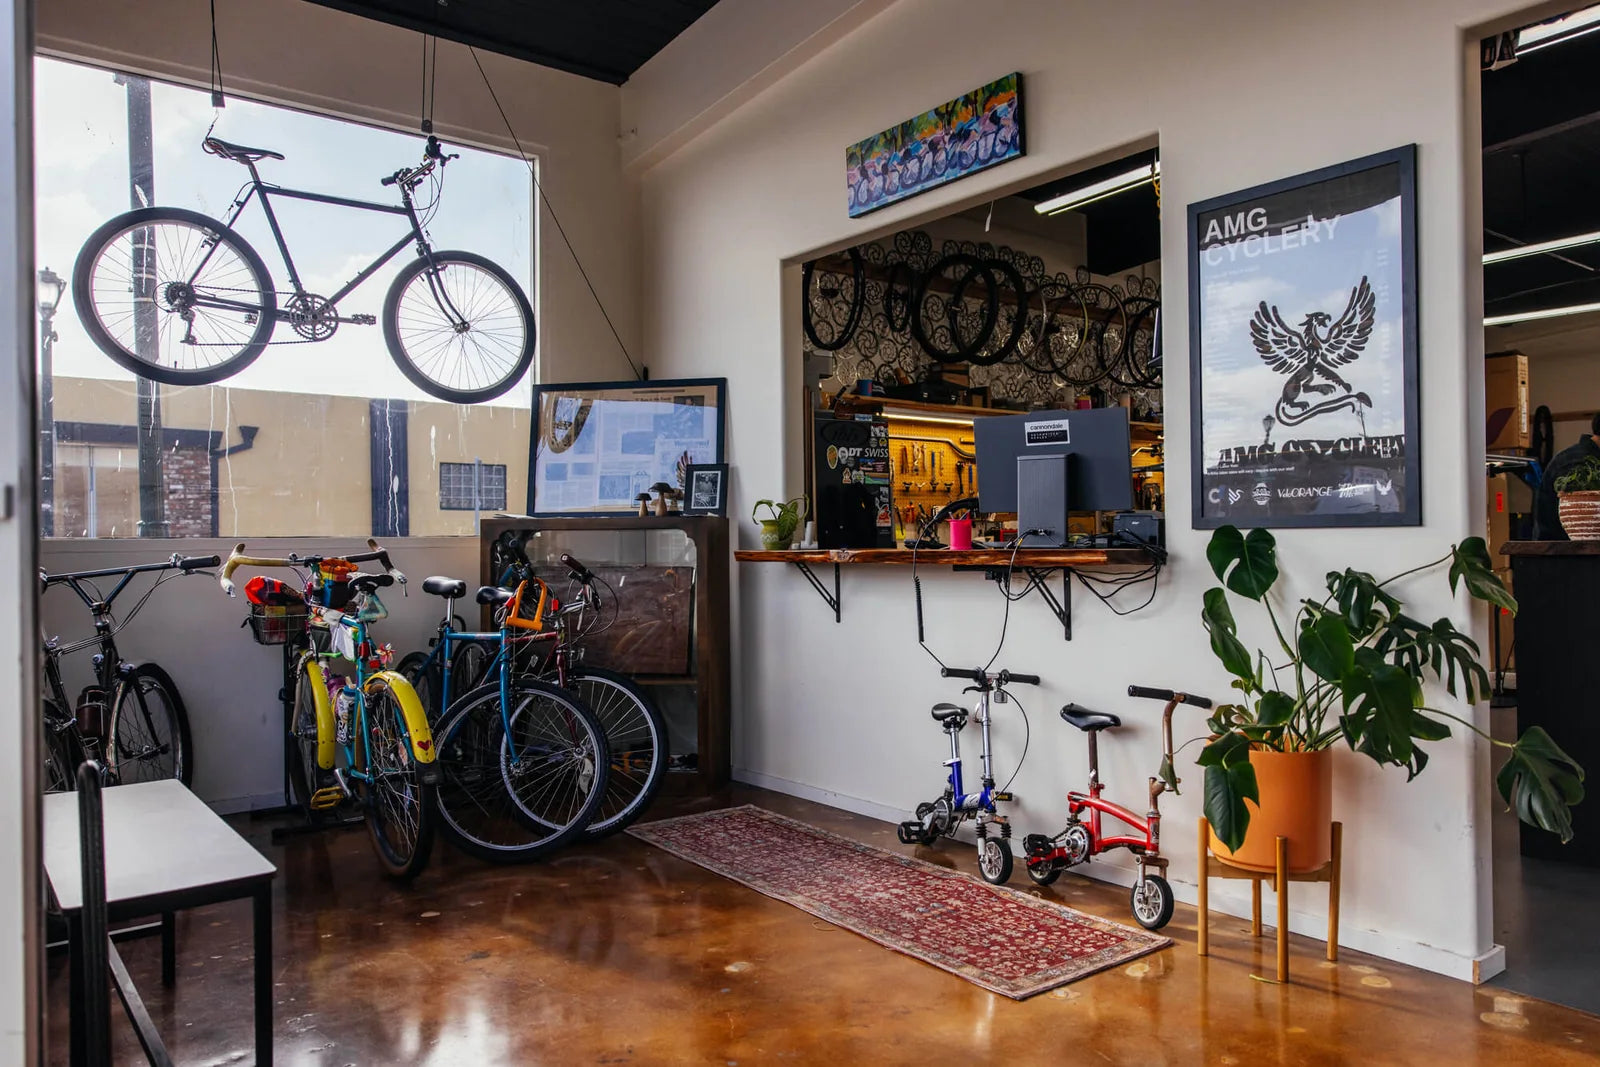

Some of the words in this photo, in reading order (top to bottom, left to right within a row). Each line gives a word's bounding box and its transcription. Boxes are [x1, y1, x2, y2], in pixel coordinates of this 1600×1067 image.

[1204, 207, 1267, 242] AMG
[1205, 214, 1341, 266] CYCLERY
[849, 448, 862, 457] DT
[864, 448, 888, 457] SWISS
